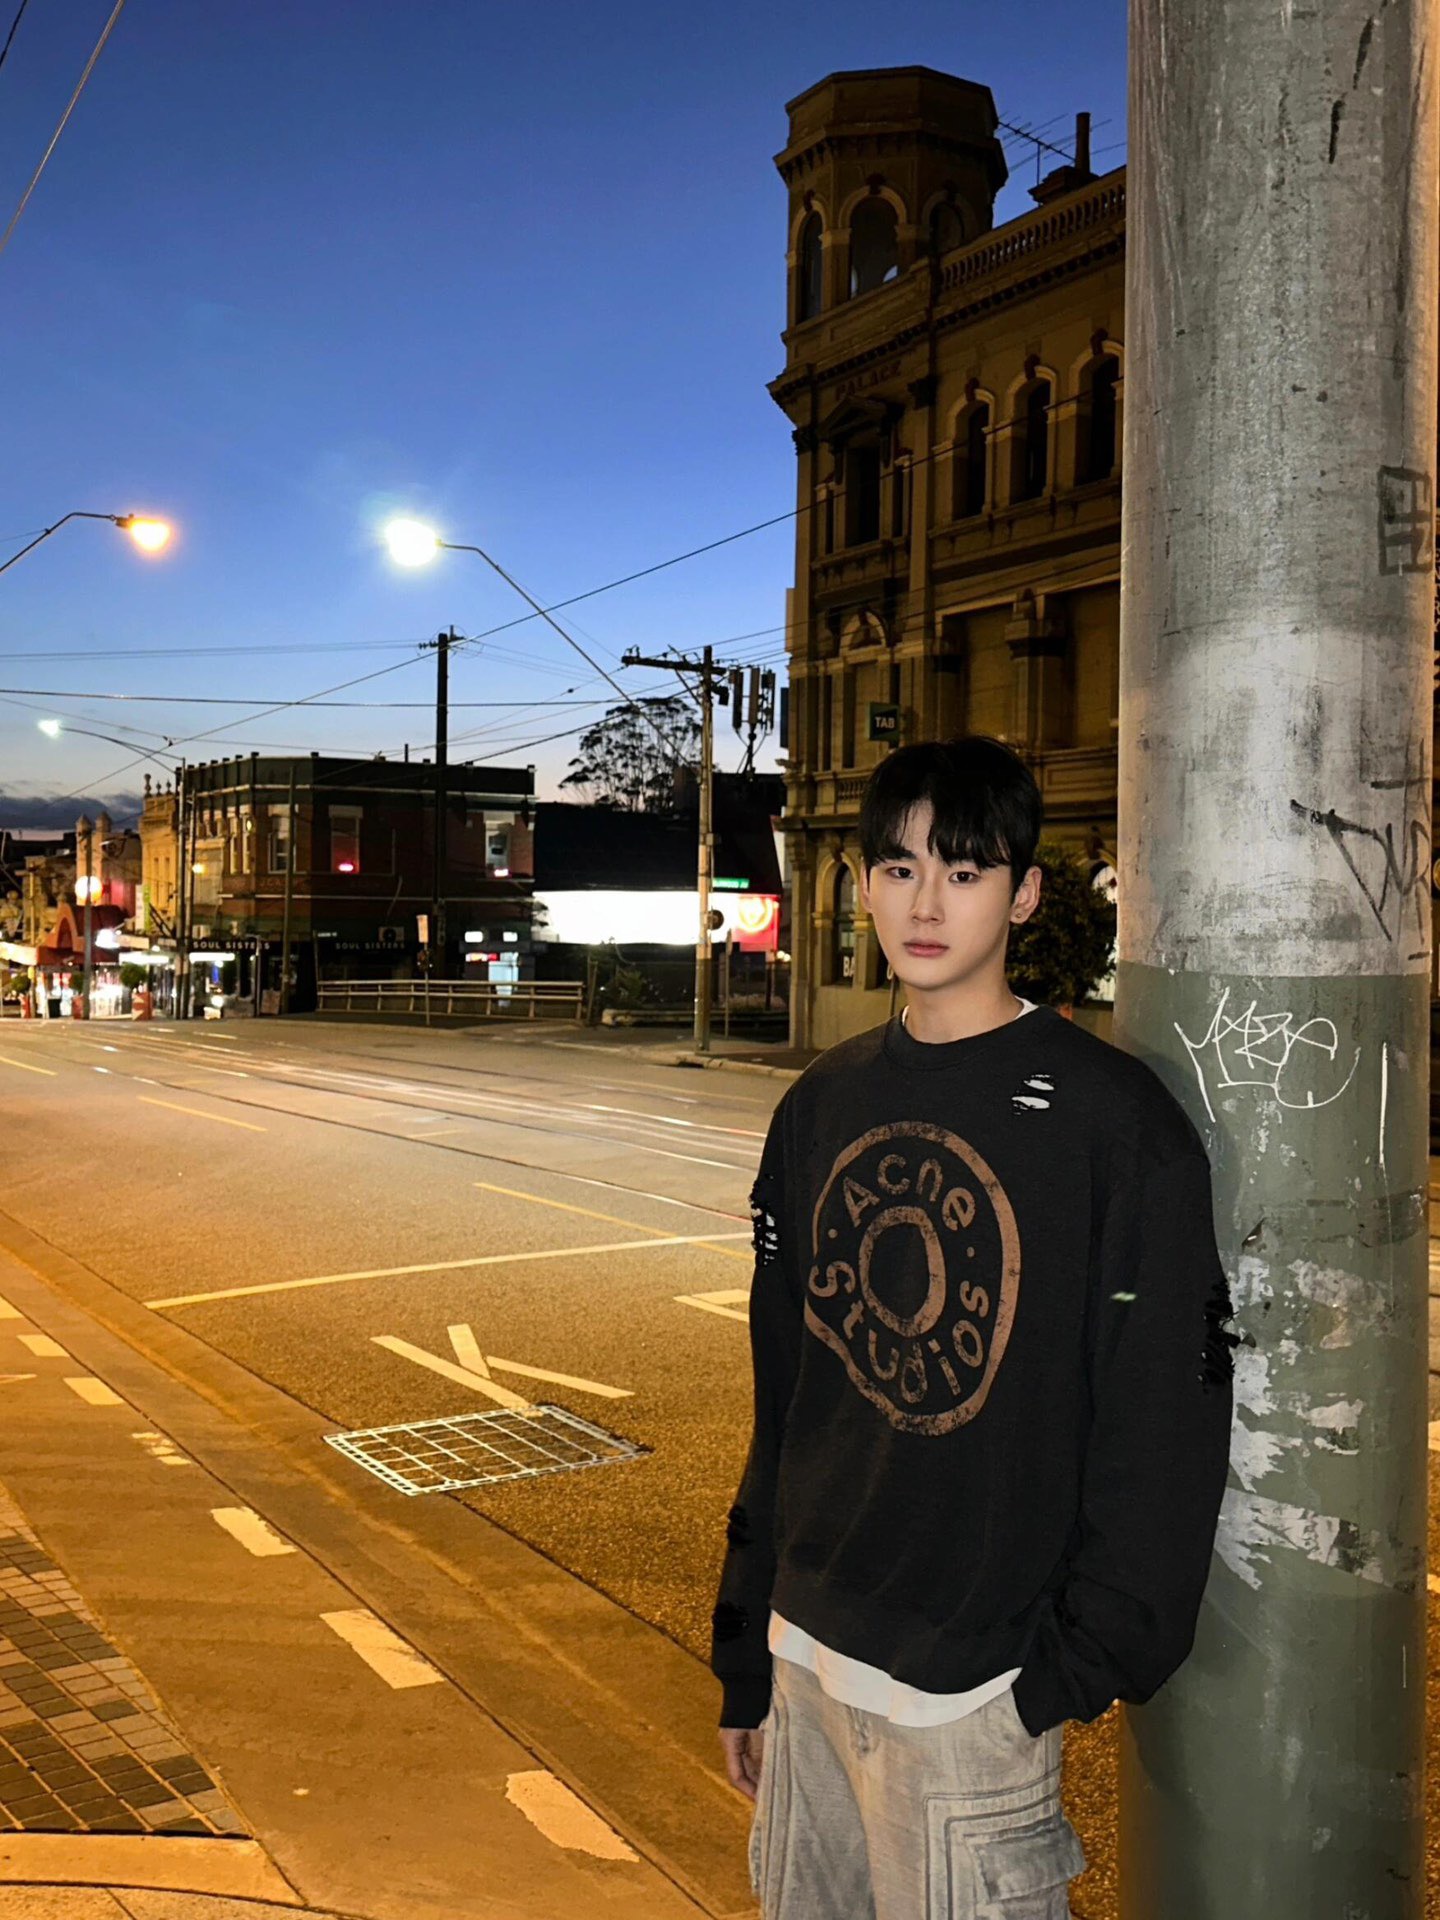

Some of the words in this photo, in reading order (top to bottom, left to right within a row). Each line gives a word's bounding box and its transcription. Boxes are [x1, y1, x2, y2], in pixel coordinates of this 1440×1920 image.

[836, 360, 903, 401] PALACE
[874, 716, 895, 729] TAB
[193, 941, 220, 950] SOUL
[225, 941, 270, 950] SISTES
[336, 942, 361, 950] SOUL
[843, 1153, 976, 1231] Acne
[808, 1261, 989, 1404] Studios
